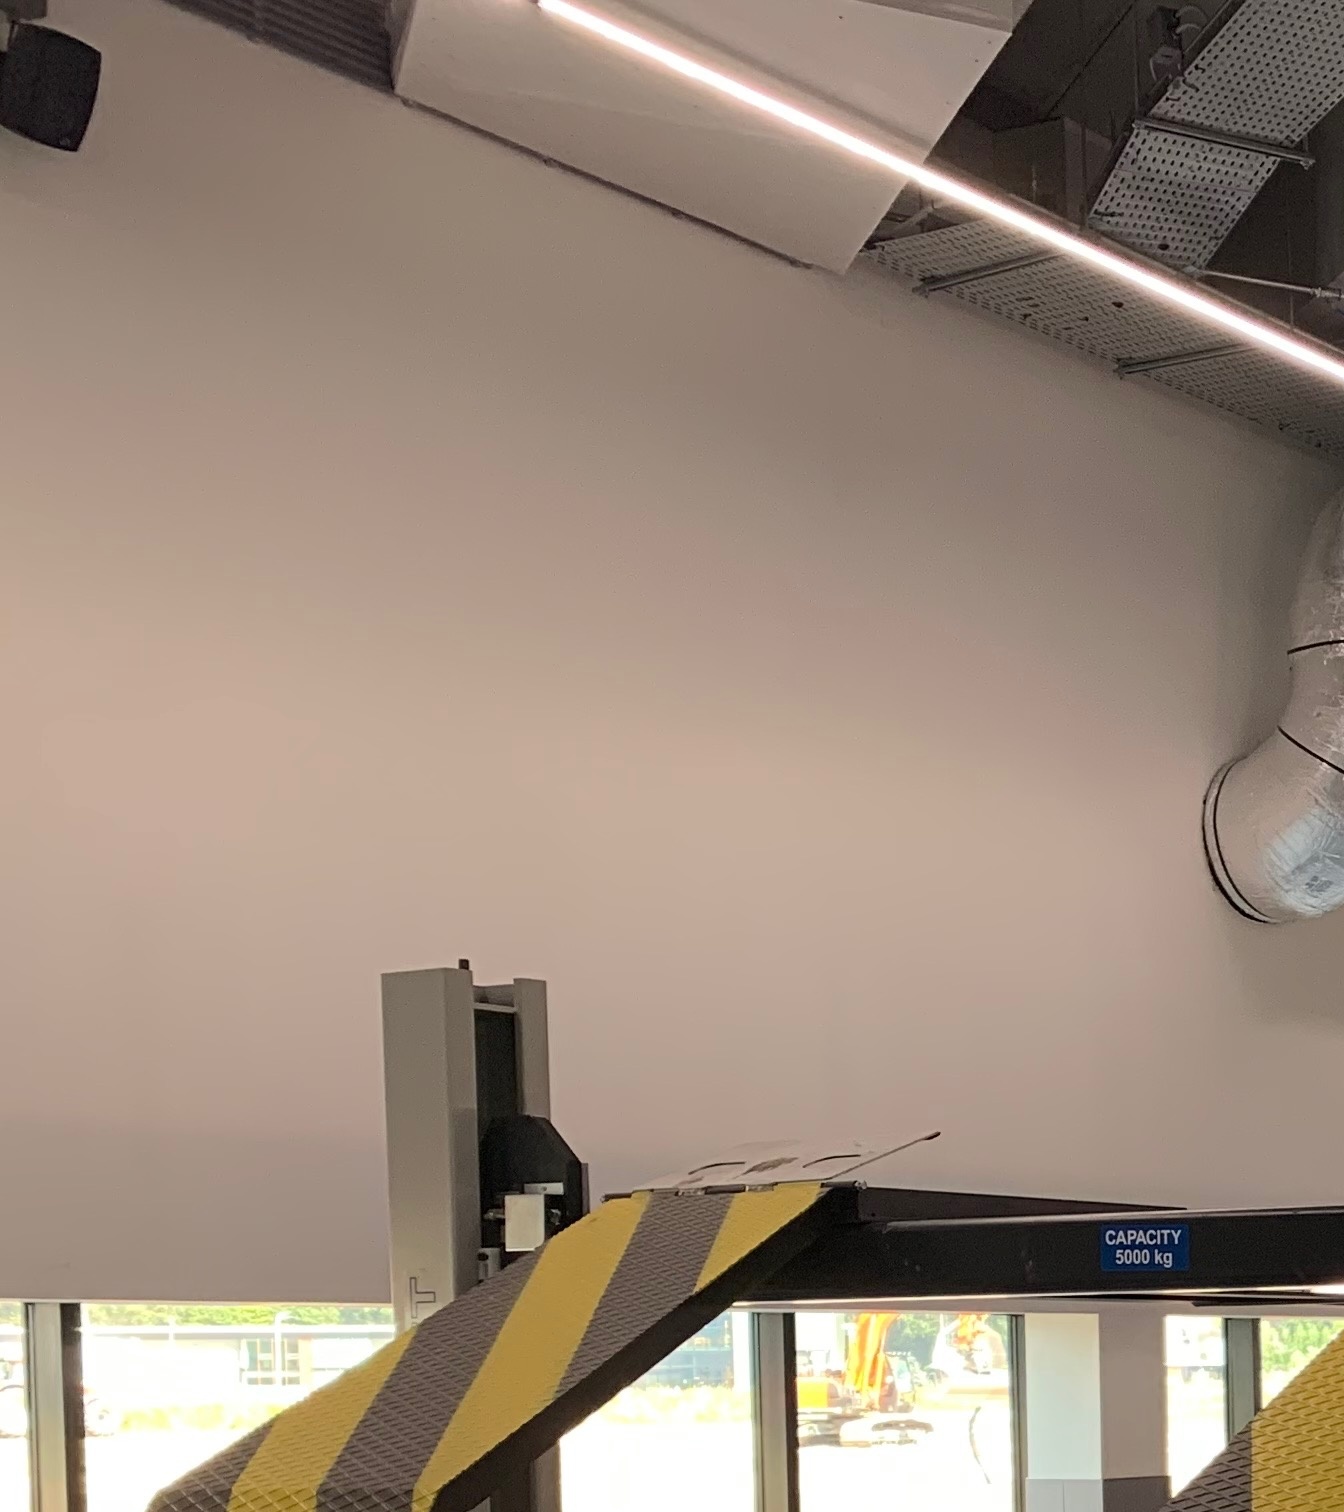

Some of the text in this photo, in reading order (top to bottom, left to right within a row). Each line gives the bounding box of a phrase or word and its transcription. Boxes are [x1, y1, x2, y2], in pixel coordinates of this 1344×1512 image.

[1105, 1230, 1181, 1245] CAPACITY
[1115, 1249, 1172, 1267] 5000 kg
